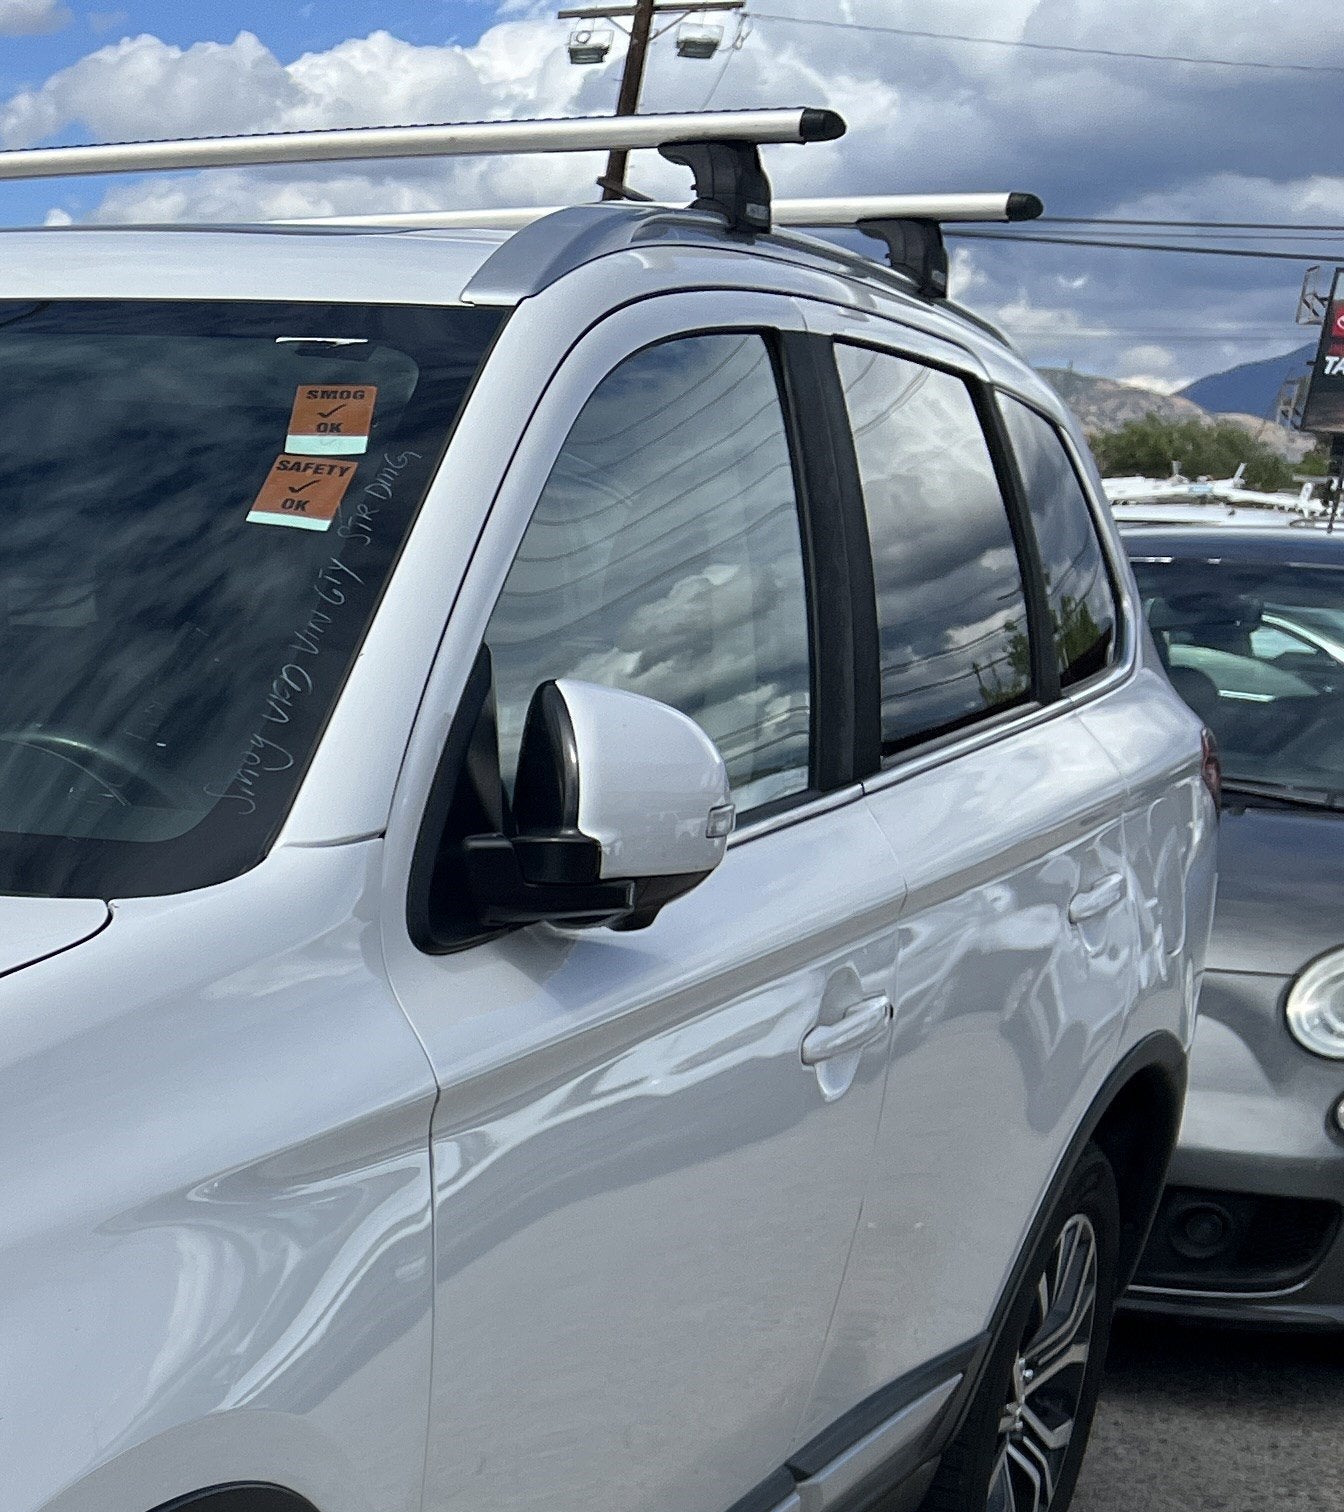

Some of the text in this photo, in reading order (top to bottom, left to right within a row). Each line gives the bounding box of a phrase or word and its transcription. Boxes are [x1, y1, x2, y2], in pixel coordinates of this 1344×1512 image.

[305, 389, 365, 401] SMOG
[316, 421, 343, 434] OK
[275, 458, 352, 479] SAFETY
[281, 497, 310, 512] OK
